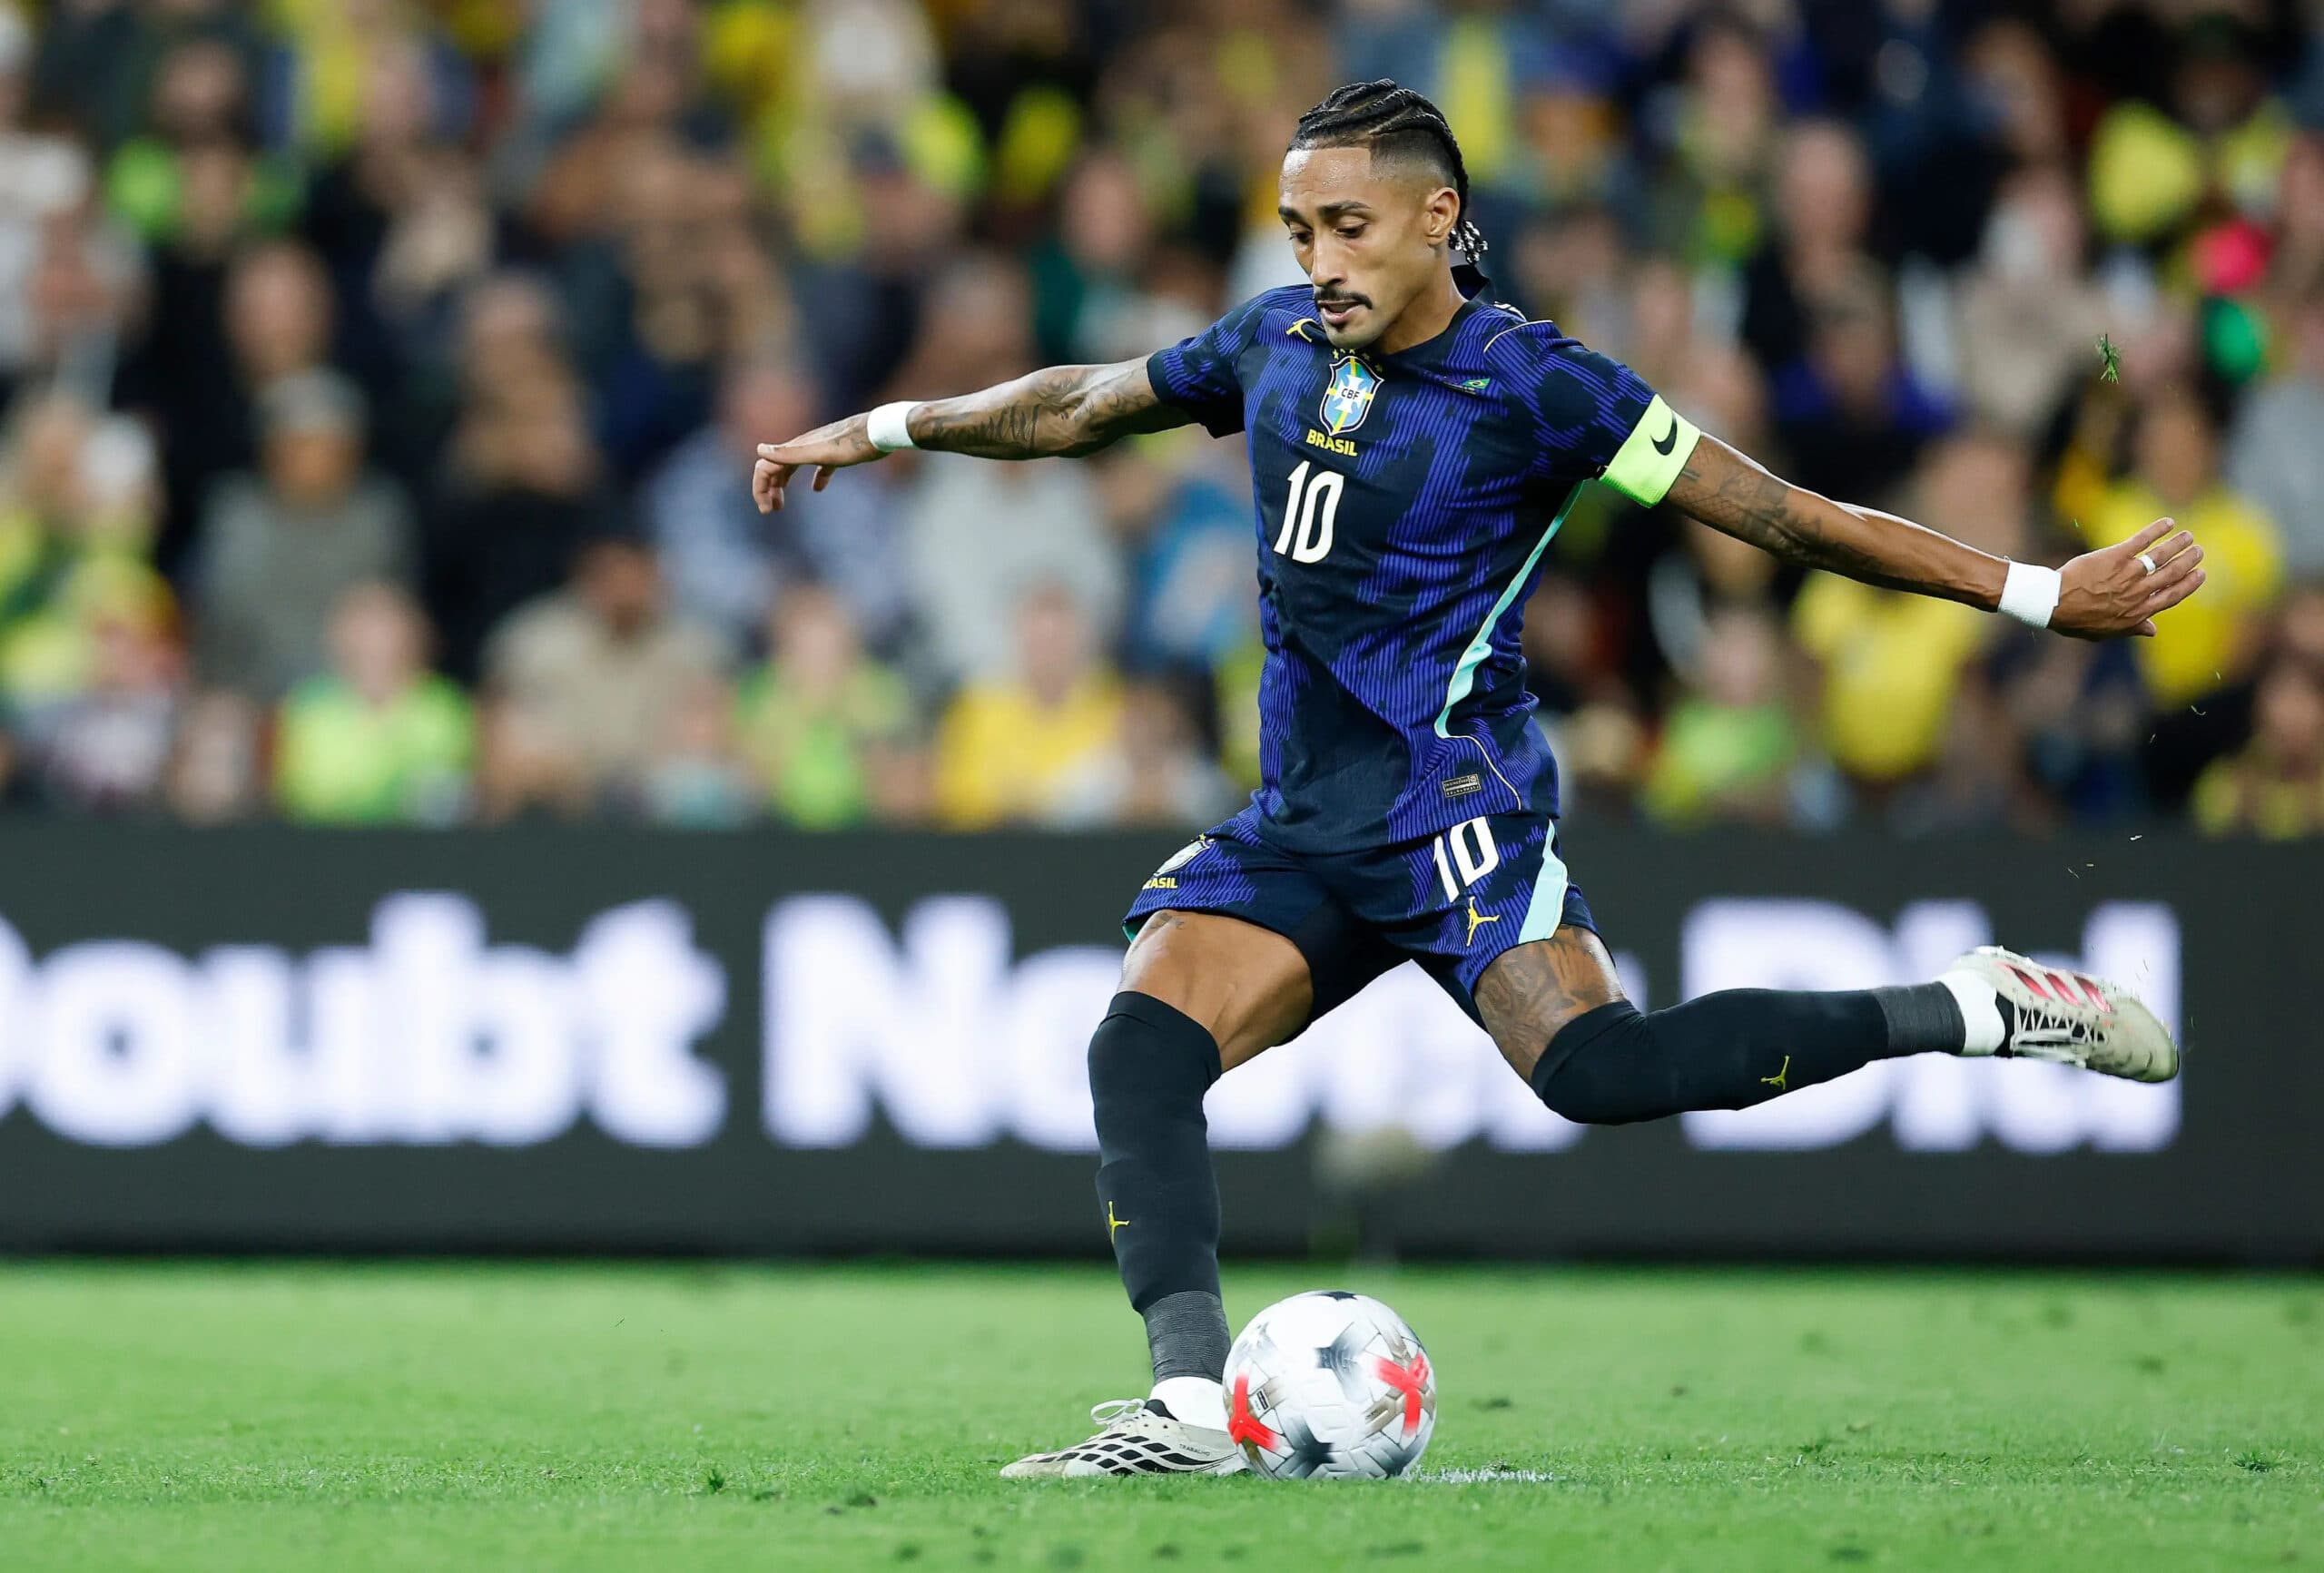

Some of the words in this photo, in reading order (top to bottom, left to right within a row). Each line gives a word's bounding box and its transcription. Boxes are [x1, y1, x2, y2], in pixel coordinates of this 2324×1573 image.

[1341, 388, 1360, 400] CBF
[1305, 428, 1358, 457] BRASIL
[1273, 460, 1344, 564] 10
[1142, 877, 1178, 890] ASIL
[1433, 816, 1500, 903] 10
[0, 894, 724, 1146] oubt
